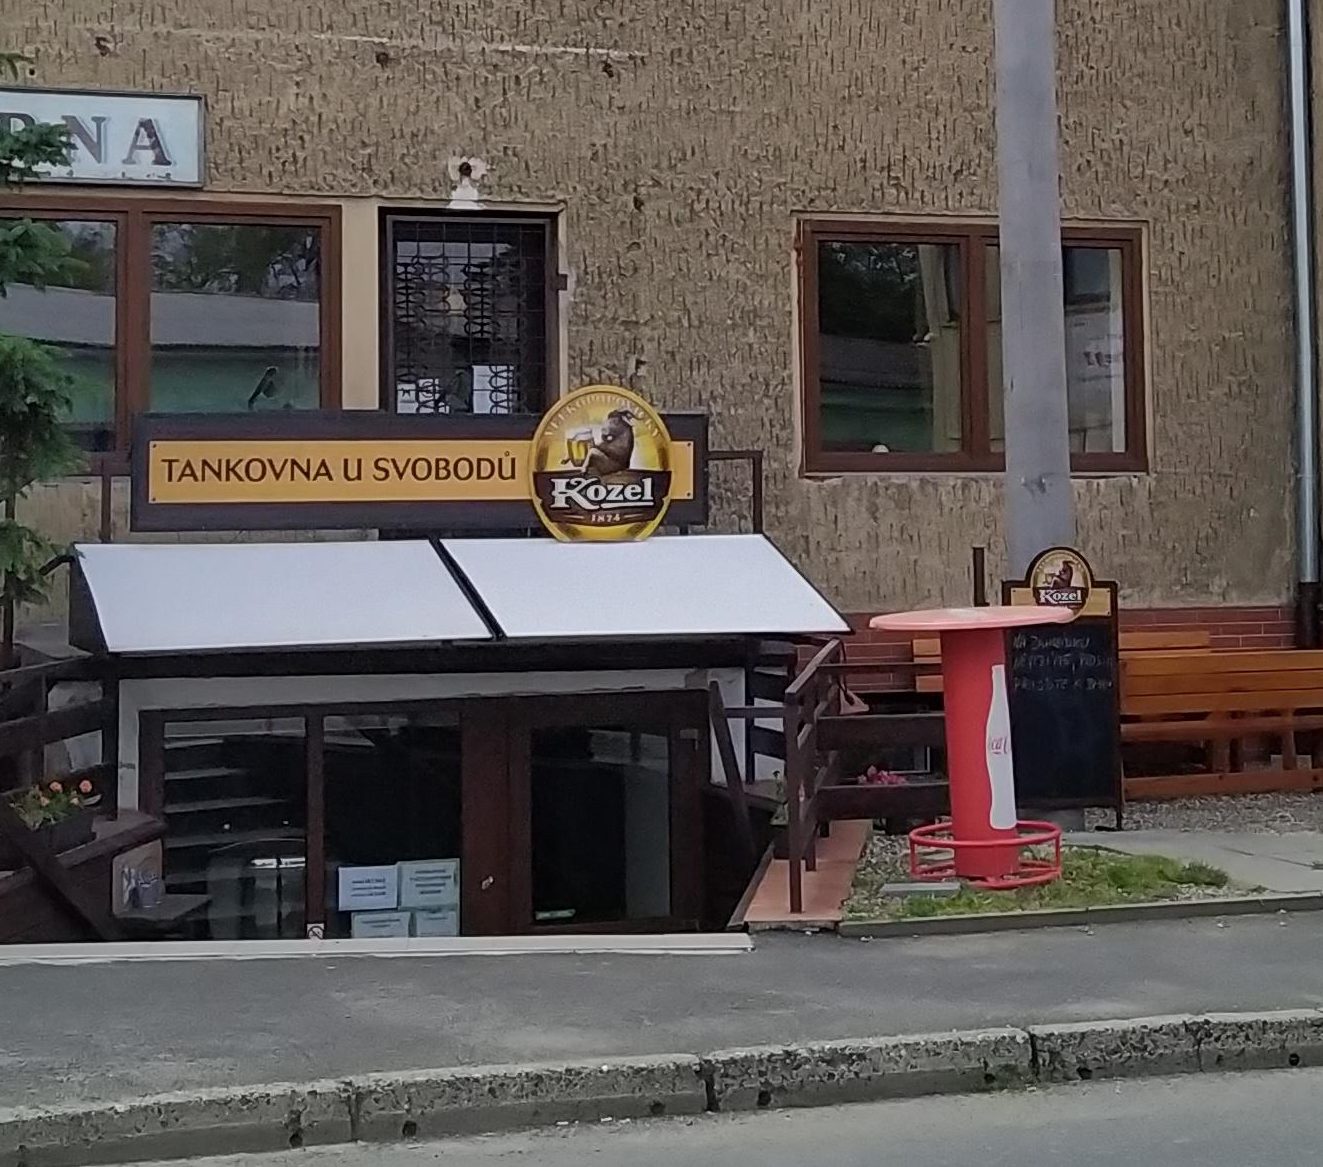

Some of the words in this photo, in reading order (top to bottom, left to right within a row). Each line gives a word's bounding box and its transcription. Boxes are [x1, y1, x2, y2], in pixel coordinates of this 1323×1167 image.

[161, 457, 333, 483] TANKOVNA
[343, 458, 362, 482] U
[372, 450, 517, 482] SVOBODŮ
[550, 477, 654, 510] Kozel
[1039, 589, 1082, 605] Kozel
